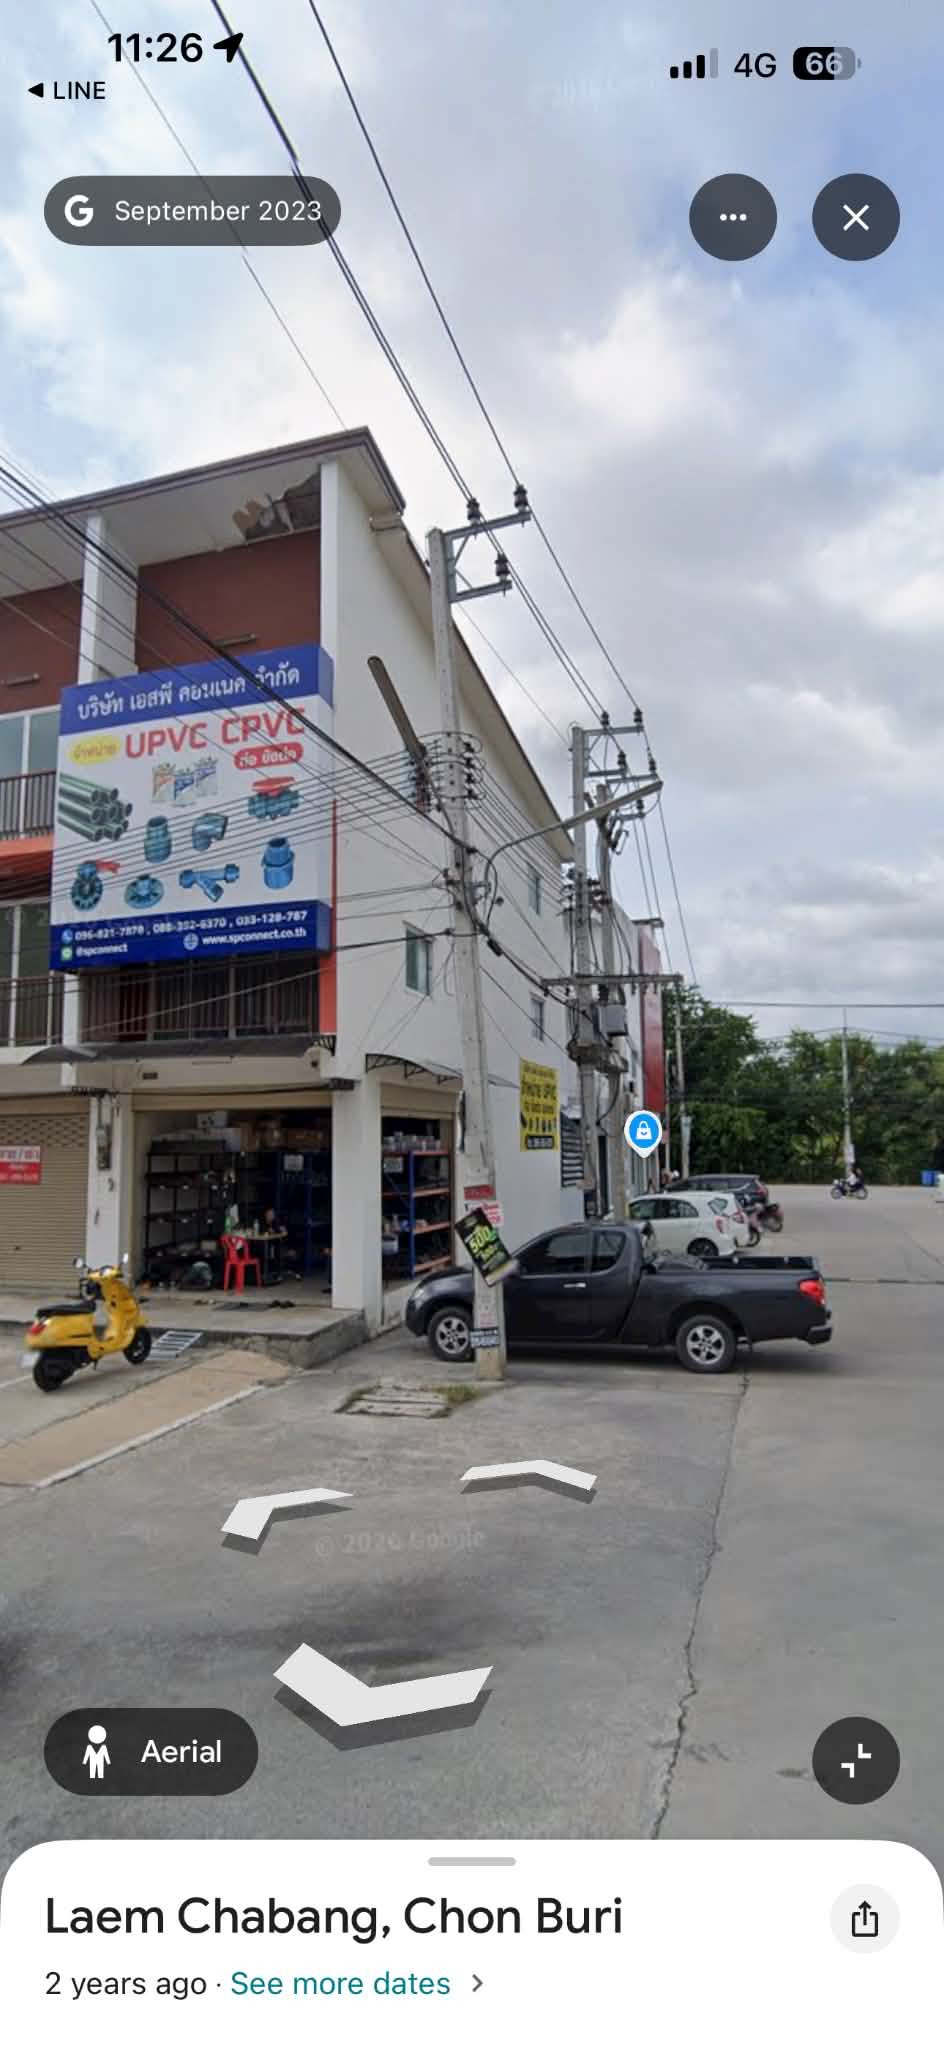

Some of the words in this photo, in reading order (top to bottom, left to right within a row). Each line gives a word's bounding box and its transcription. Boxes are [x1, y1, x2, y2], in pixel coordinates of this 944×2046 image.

[78, 690, 124, 720] บริษัท
[131, 681, 172, 711] เอสพี
[255, 660, 300, 689] จำกัด
[126, 722, 208, 760] UPVC
[221, 704, 305, 745] CPVC
